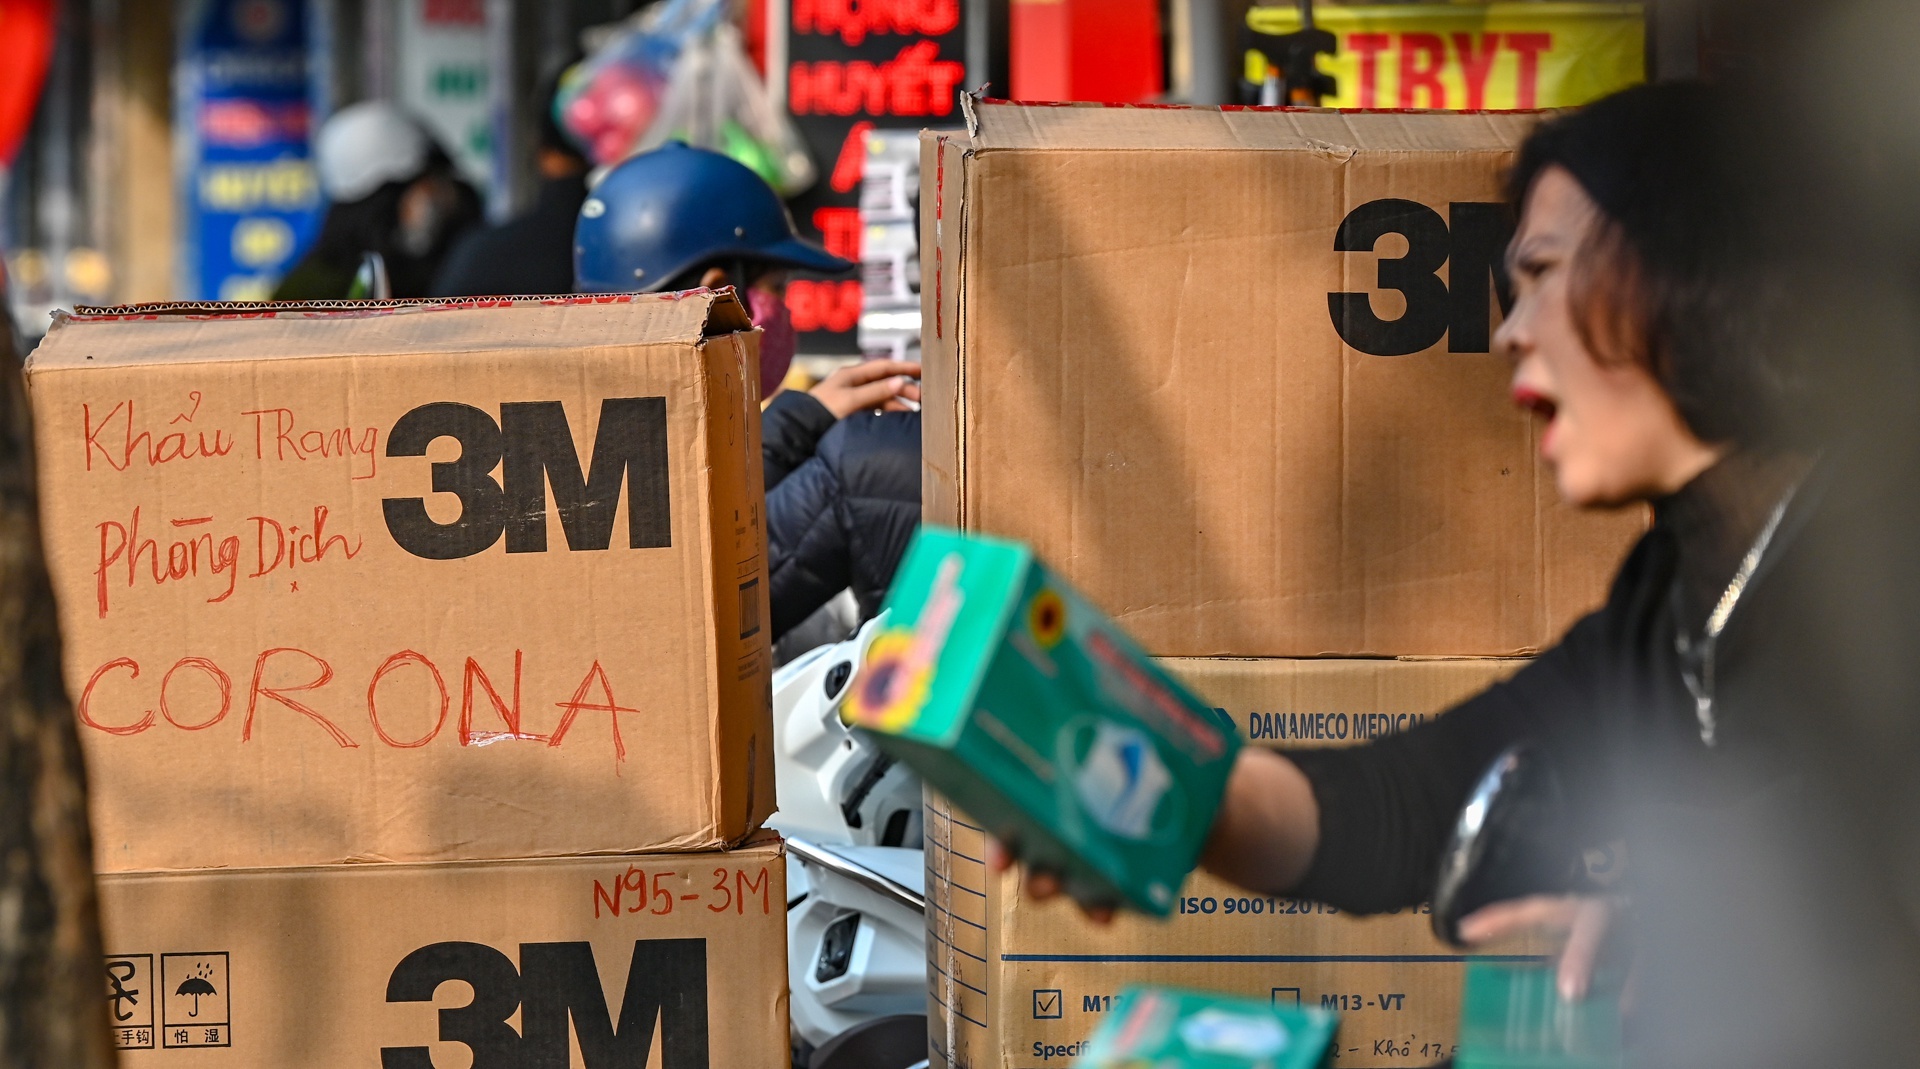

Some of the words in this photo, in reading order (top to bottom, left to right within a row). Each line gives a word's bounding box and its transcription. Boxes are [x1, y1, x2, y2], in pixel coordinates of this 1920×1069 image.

[789, 40, 965, 116] HUYẾT
[1347, 32, 1553, 109] TRYT
[382, 396, 671, 560] 3M
[79, 648, 639, 776] CORONA
[1249, 712, 1348, 740] DANAMECO
[1180, 897, 1218, 914] ISO
[381, 938, 709, 1069] 3M
